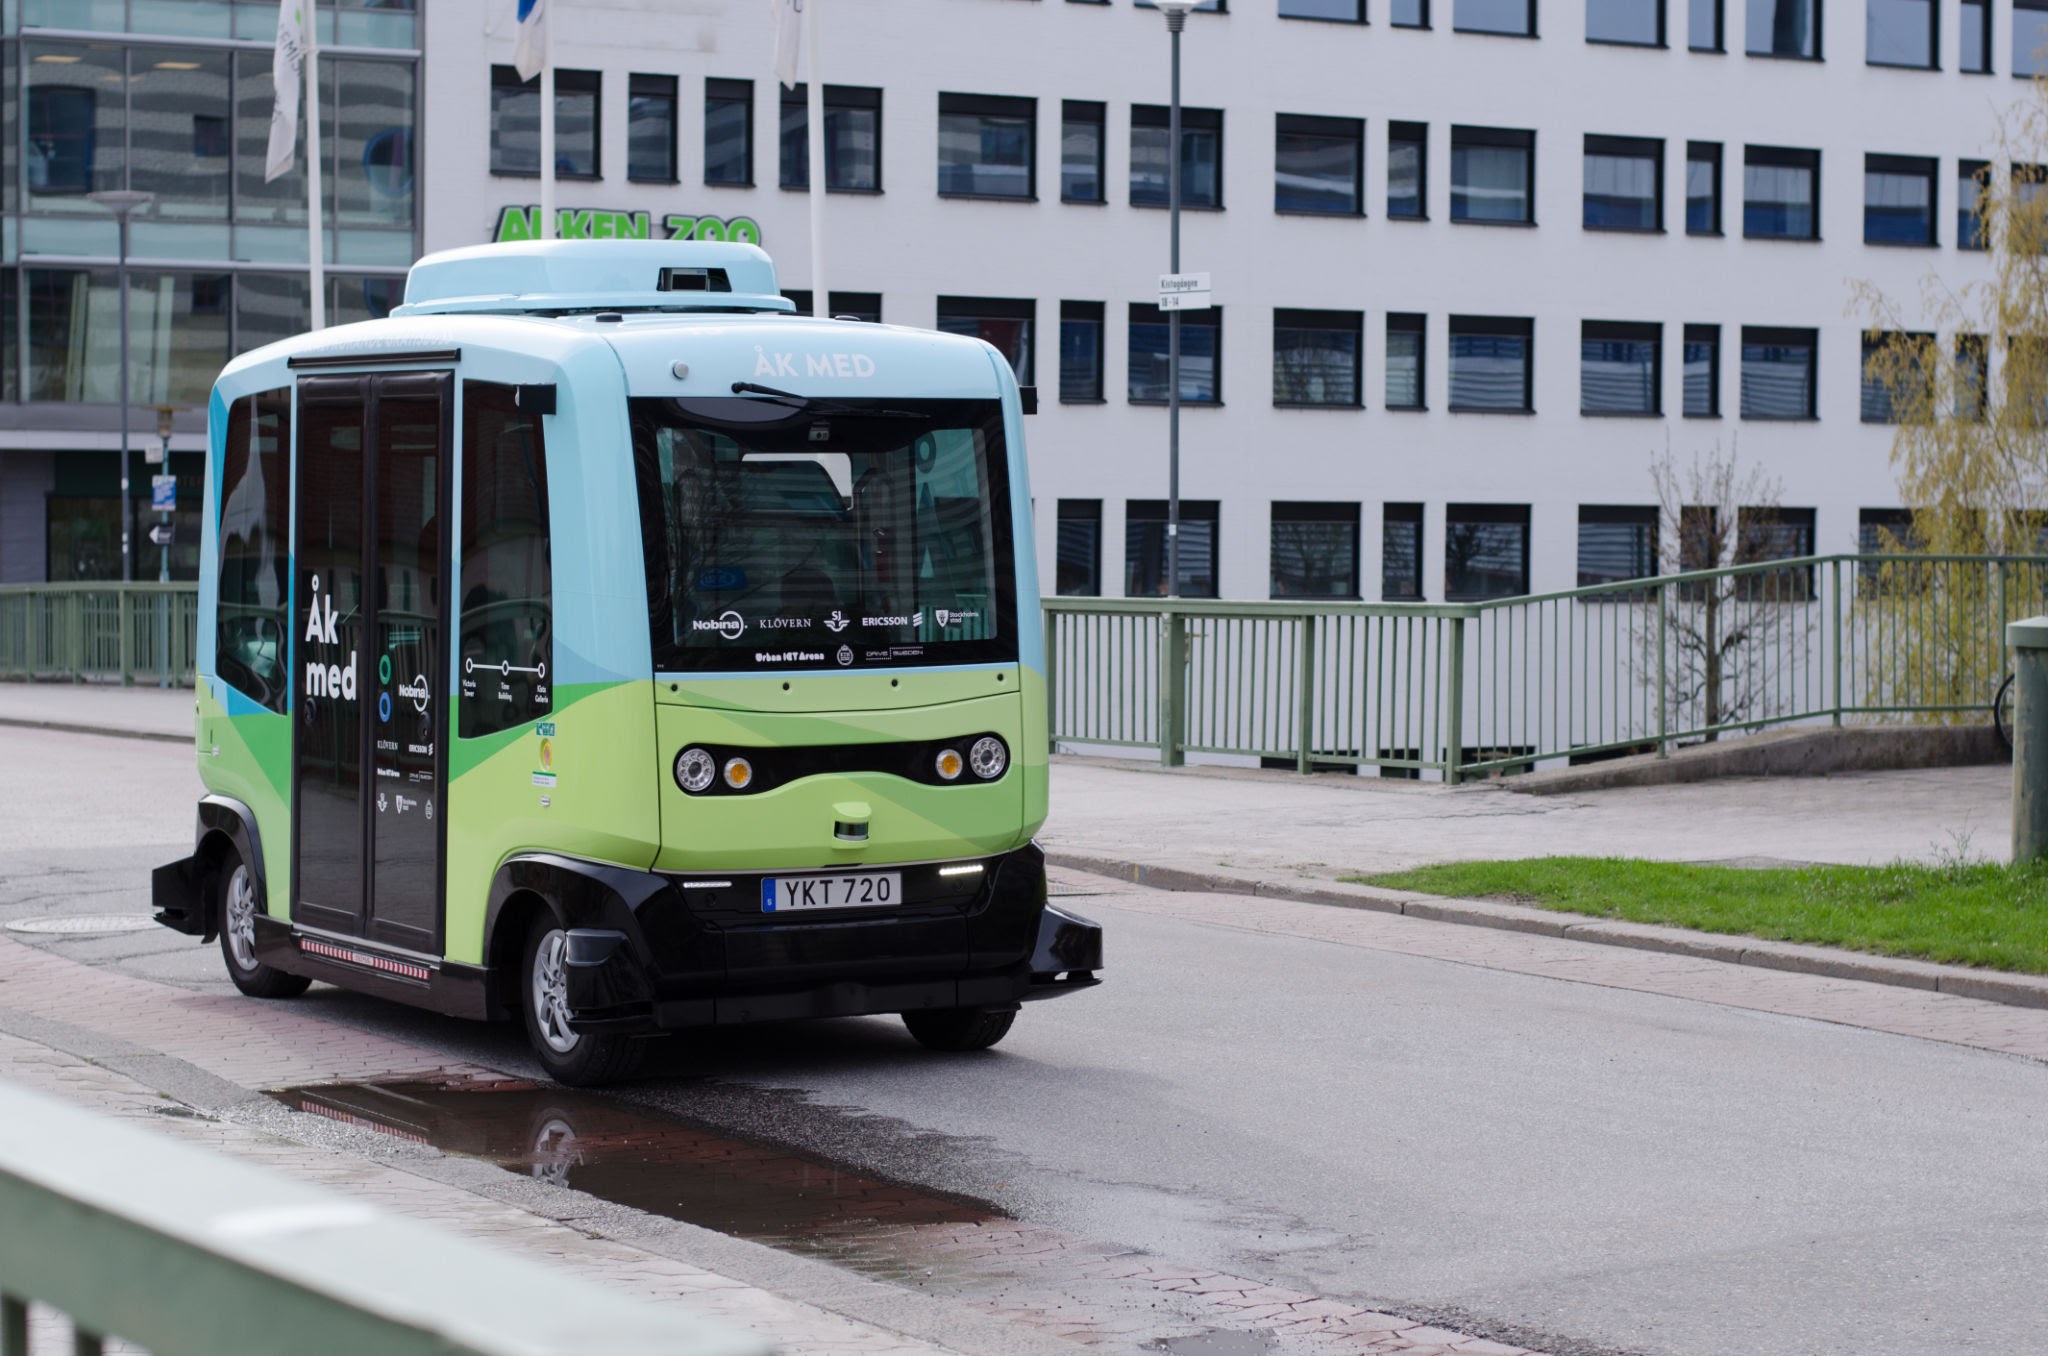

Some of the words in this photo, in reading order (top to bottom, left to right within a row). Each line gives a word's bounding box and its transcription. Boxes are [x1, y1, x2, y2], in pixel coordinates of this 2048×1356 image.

[664, 214, 760, 244] ZOO
[753, 344, 799, 377] ÅK
[805, 352, 877, 378] MED
[305, 573, 339, 645] Åk
[759, 618, 812, 629] KLÖVERN
[831, 610, 842, 621] SJ
[862, 616, 908, 627] ERICSSON
[755, 652, 782, 662] Urban
[306, 650, 357, 701] med
[785, 879, 834, 907] YKT
[843, 877, 891, 904] 720
